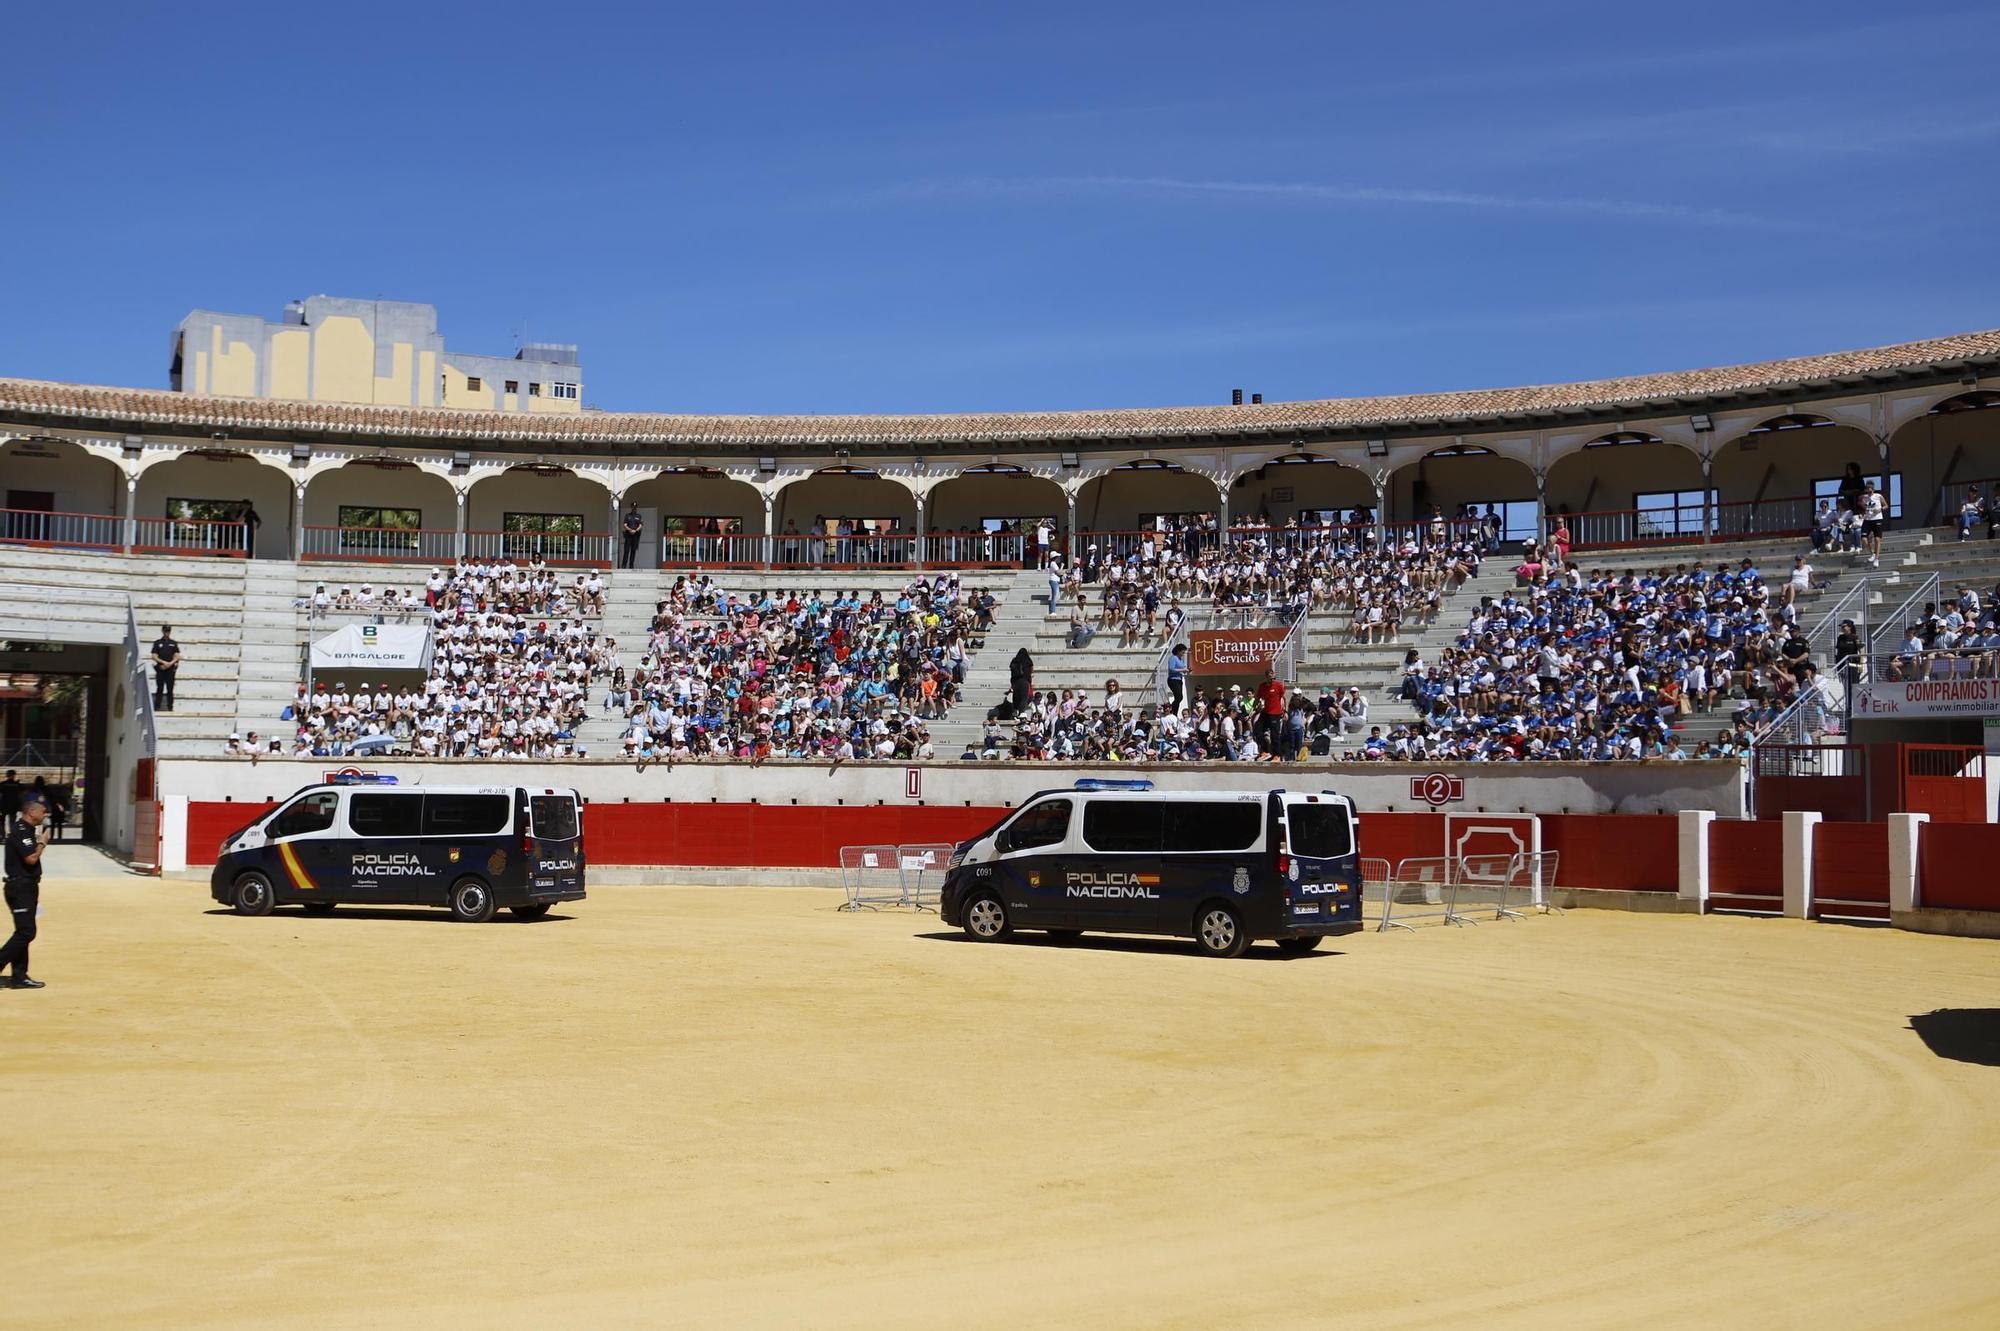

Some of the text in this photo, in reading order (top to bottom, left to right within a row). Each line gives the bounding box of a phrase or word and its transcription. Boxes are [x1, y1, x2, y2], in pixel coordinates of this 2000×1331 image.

[363, 626, 377, 636] B
[1214, 638, 1286, 655] Franpim
[1214, 653, 1260, 664] Servicios
[1906, 680, 1987, 702] COMPRAMOS
[1872, 700, 1899, 713] Erik
[1431, 779, 1443, 798] 2
[352, 866, 436, 875] NACIONAL
[1066, 873, 1140, 885] POLICIA
[1066, 886, 1160, 898] NACIONAL
[1302, 883, 1341, 895] POLICIA
